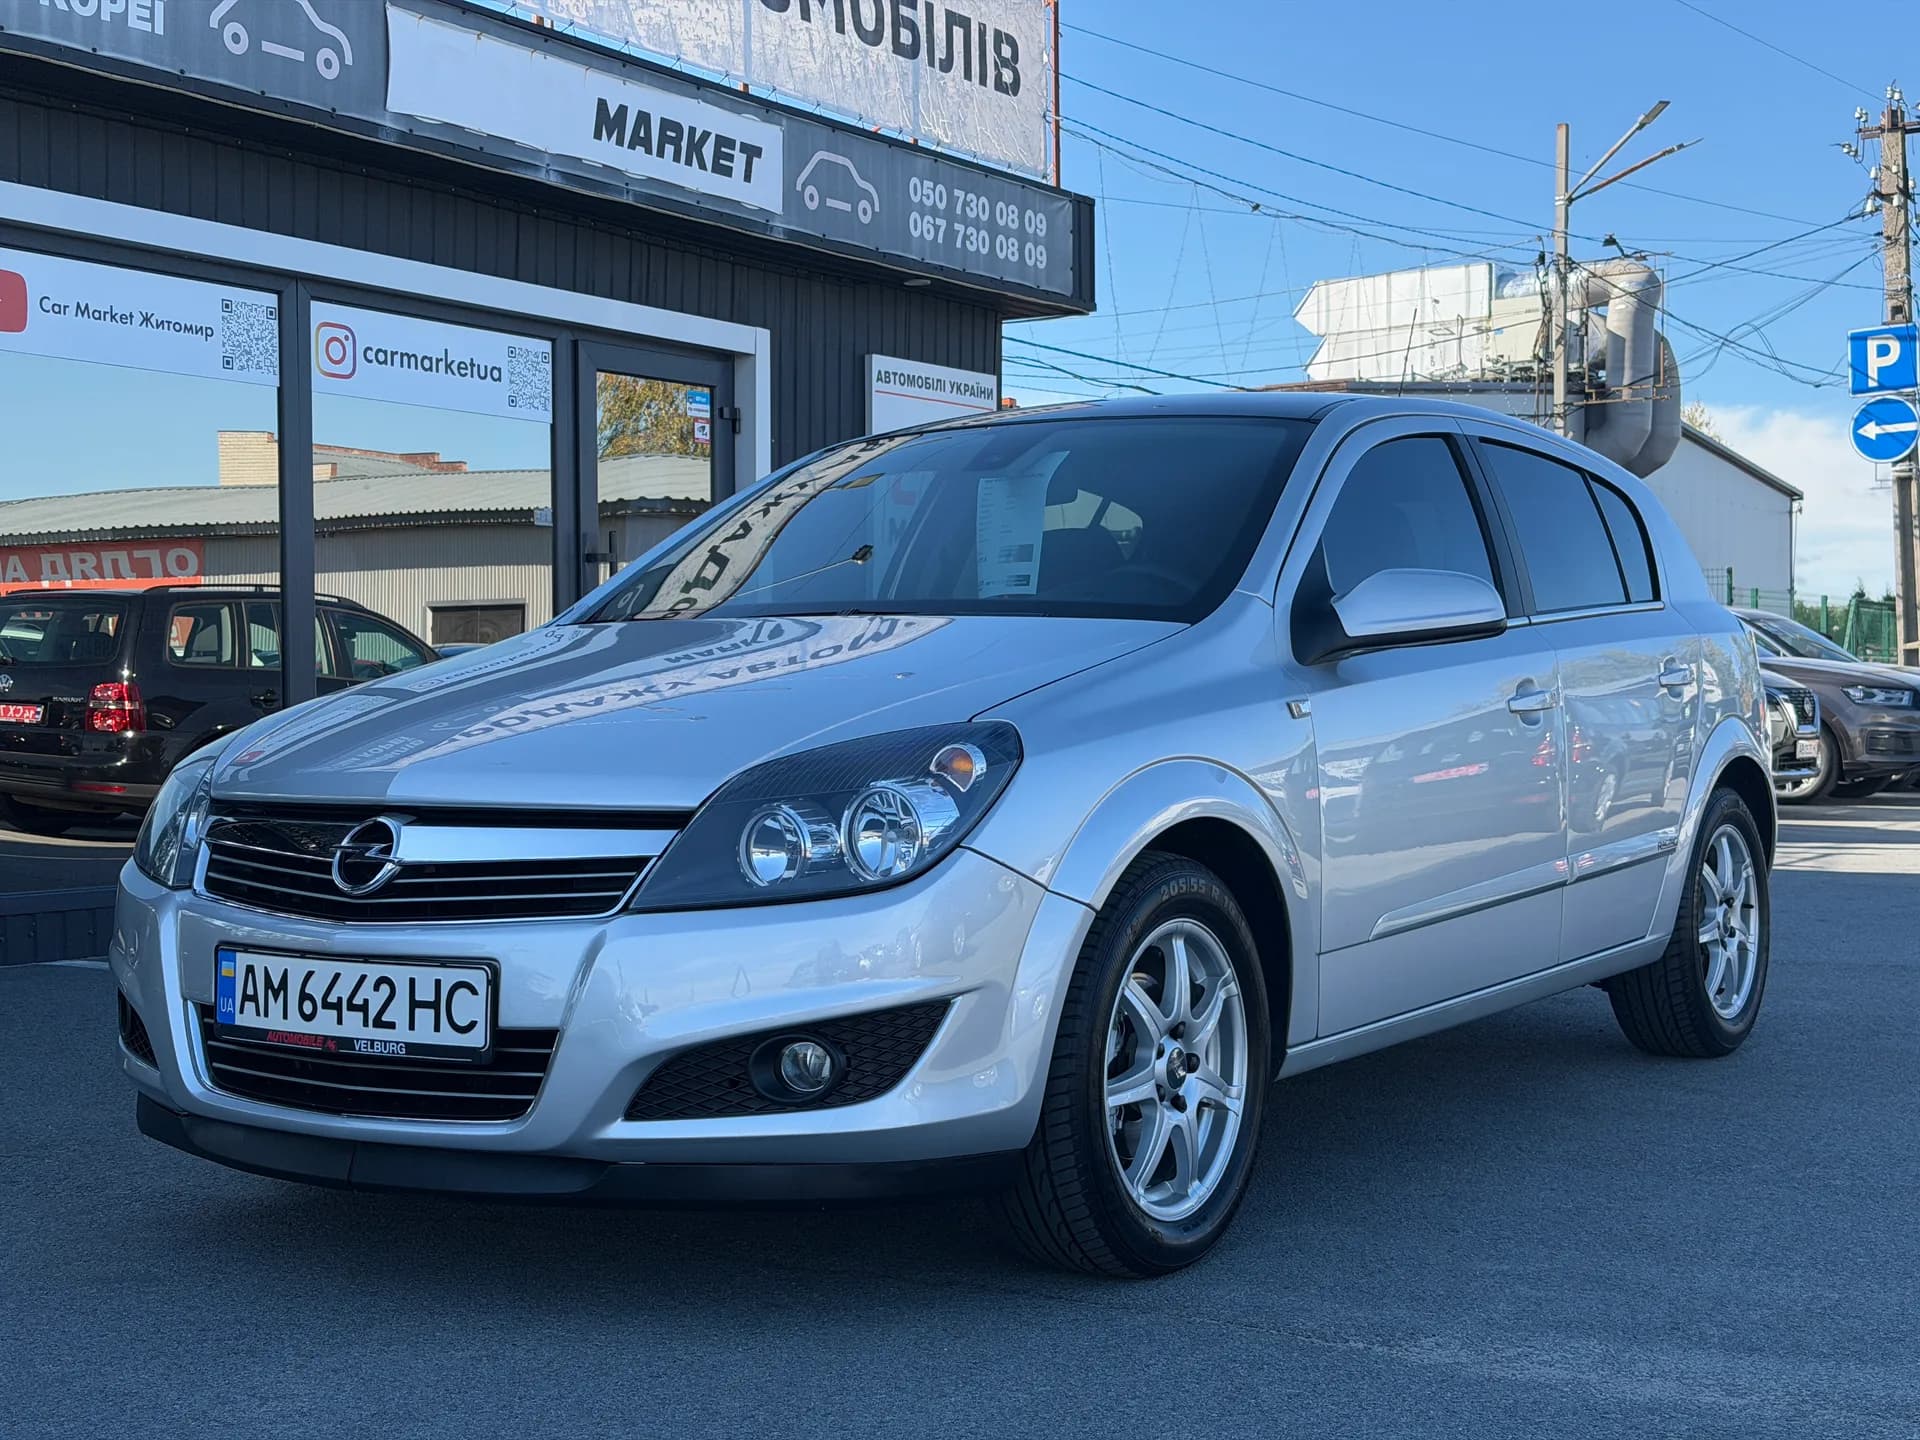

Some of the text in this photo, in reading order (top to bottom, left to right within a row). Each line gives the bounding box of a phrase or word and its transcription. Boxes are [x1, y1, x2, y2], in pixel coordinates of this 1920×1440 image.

[39, 0, 166, 36] РЕЇ
[759, 0, 1020, 97] ОБІЛІВ
[593, 97, 763, 184] MARKET
[909, 177, 1047, 237] 050 730 08 09
[909, 211, 1047, 269] 067 730 08 09
[39, 296, 214, 341] Car Market Житомир
[362, 345, 502, 383] carmarketua
[1867, 334, 1901, 388] P
[876, 369, 994, 401] АВТОМОБІЛІ УКРАЇНИ
[220, 998, 234, 1014] UA
[267, 1031, 324, 1047] AUTOMOBILE
[353, 1039, 406, 1055] VELBURG
